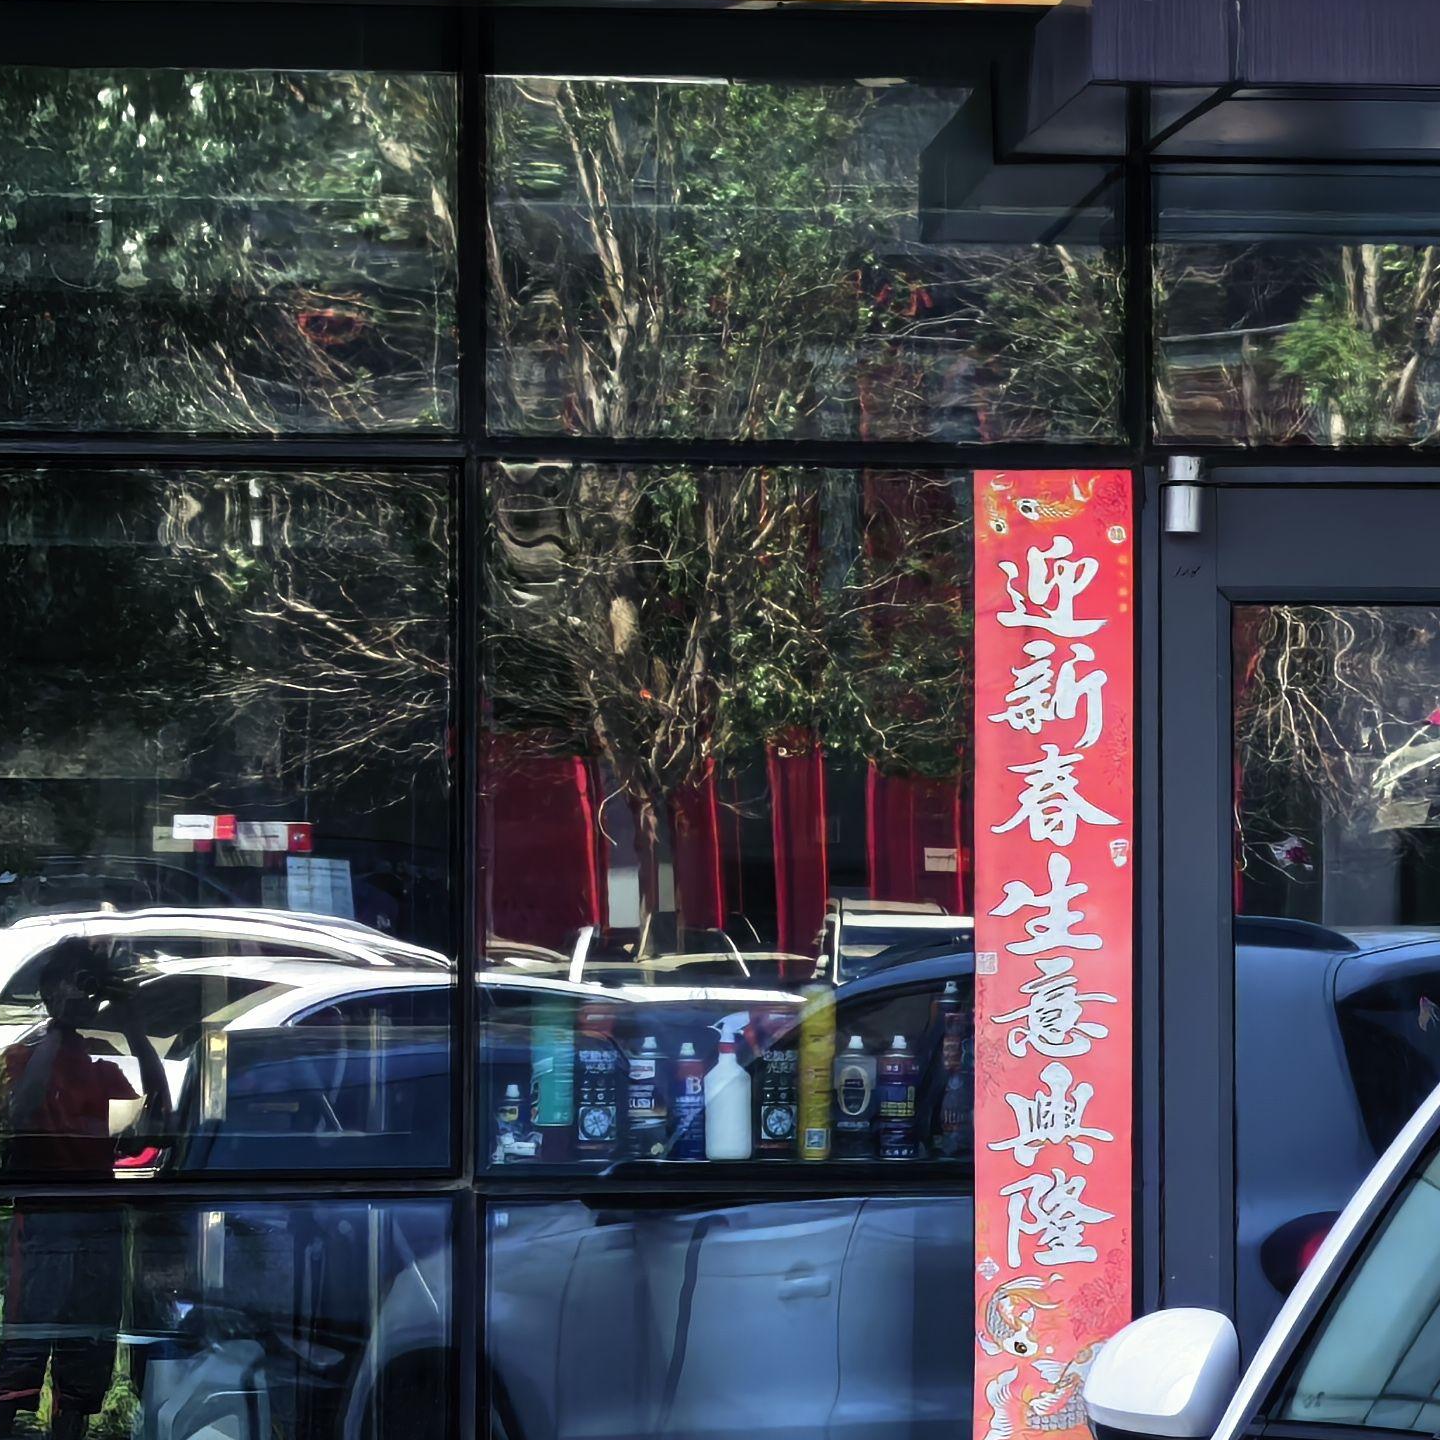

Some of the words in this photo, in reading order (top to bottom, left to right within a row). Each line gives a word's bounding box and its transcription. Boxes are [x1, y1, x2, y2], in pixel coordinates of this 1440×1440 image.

[986, 535, 1123, 1270] 迎新春生意興隆
